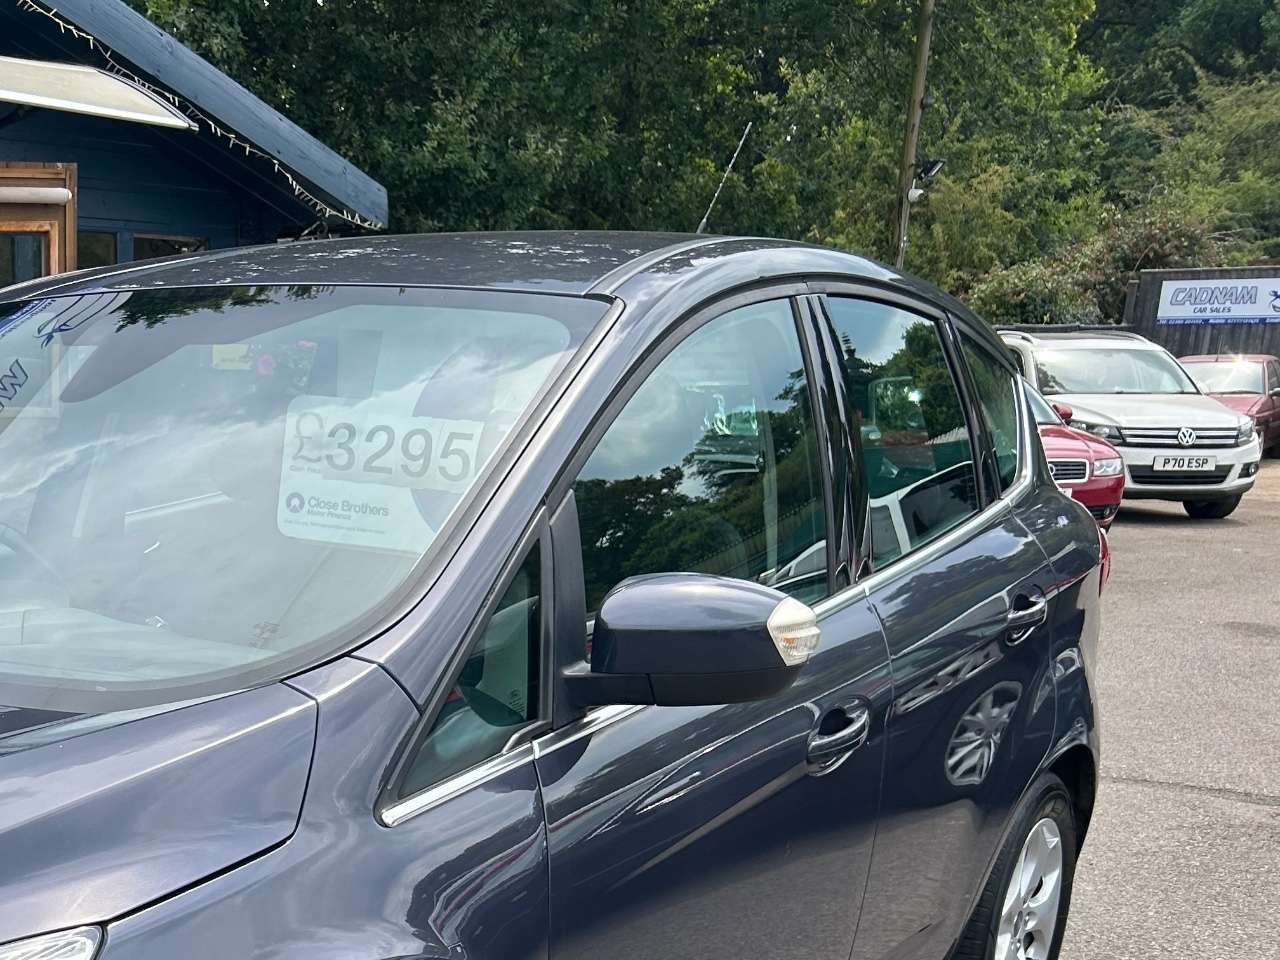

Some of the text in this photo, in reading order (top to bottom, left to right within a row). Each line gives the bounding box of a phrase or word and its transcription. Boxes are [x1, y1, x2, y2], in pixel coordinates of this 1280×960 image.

[1169, 285, 1259, 306] CADNAM
[1193, 306, 1208, 314] CAR
[292, 411, 474, 482] £3295
[1163, 457, 1209, 468] P70 ESP
[307, 495, 390, 517] Close Brothers
